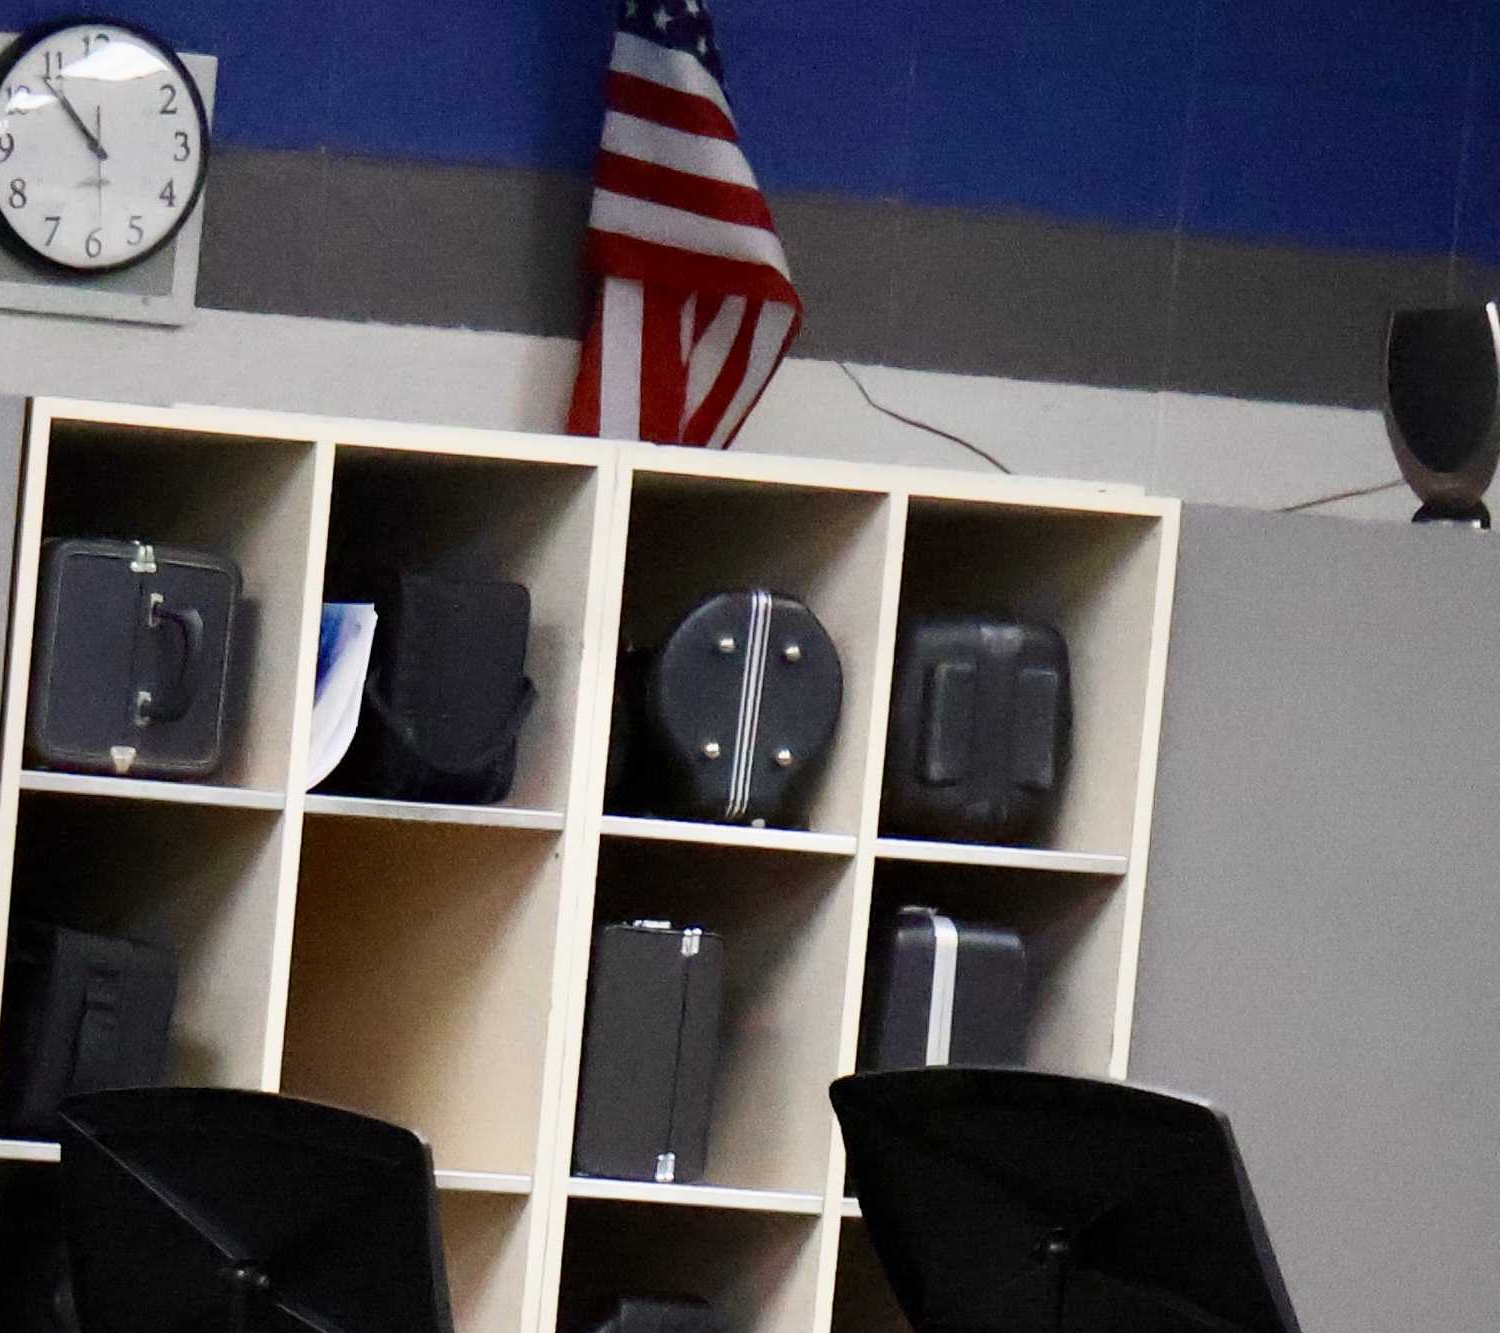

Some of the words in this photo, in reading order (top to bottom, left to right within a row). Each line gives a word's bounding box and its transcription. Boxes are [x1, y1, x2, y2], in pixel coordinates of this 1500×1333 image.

[159, 84, 178, 115] 2
[173, 131, 190, 162] 3
[9, 178, 27, 208] 8
[159, 179, 177, 208] 4
[44, 215, 61, 247] 7
[85, 227, 102, 258] 6
[127, 215, 144, 246] 5
